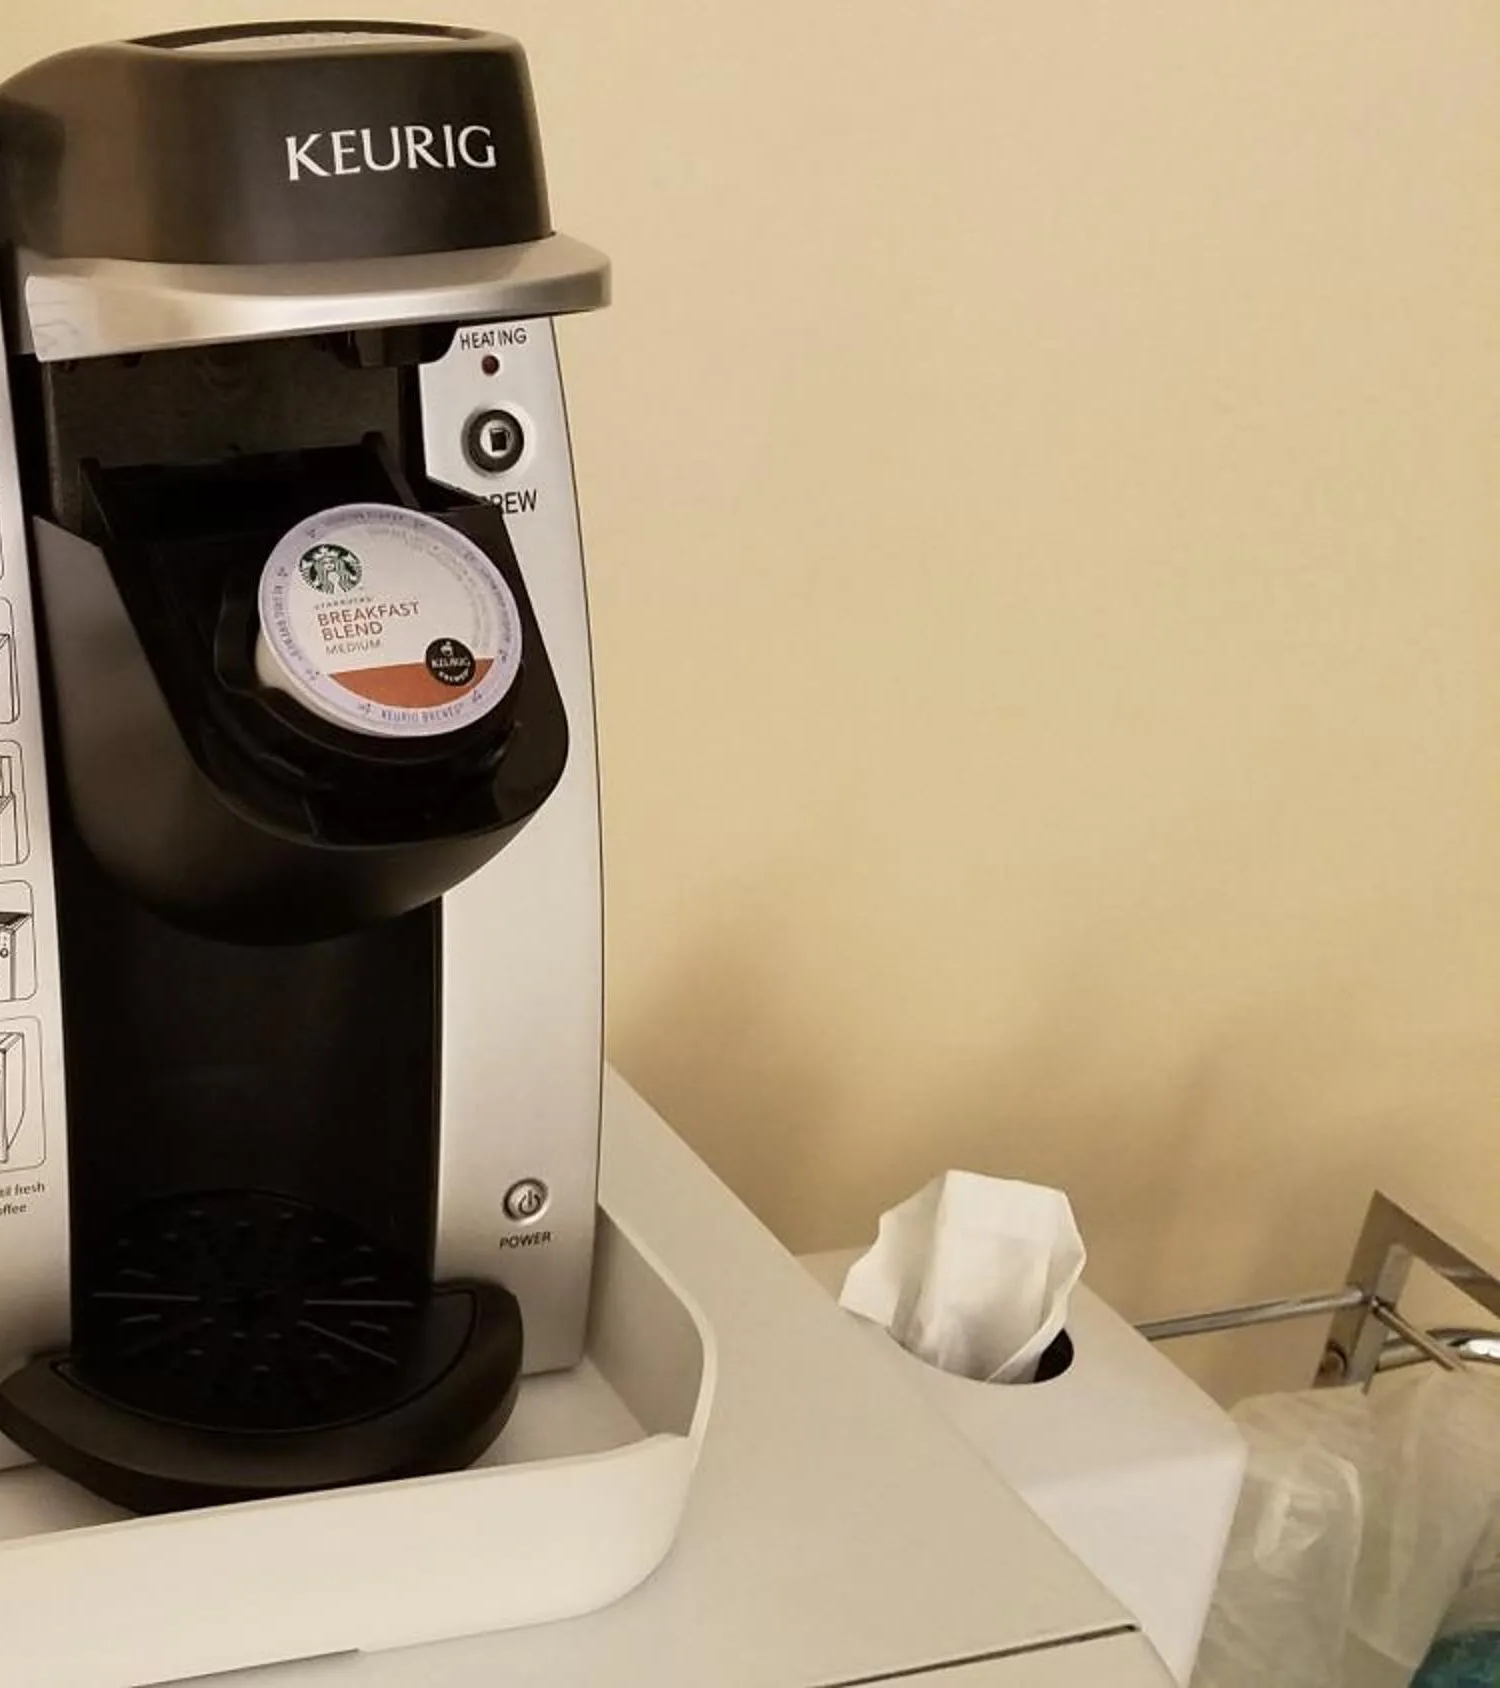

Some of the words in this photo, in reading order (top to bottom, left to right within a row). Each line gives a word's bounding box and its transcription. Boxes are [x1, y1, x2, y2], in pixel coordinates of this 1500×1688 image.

[285, 123, 497, 182] KEURIG
[460, 328, 527, 350] HEATING
[489, 489, 537, 514] REW
[317, 601, 419, 627] BREAKFAST
[321, 621, 383, 641] BLEND
[325, 639, 381, 654] MEDIUM
[14, 1182, 46, 1196] fresh
[499, 1231, 551, 1250] POWER
